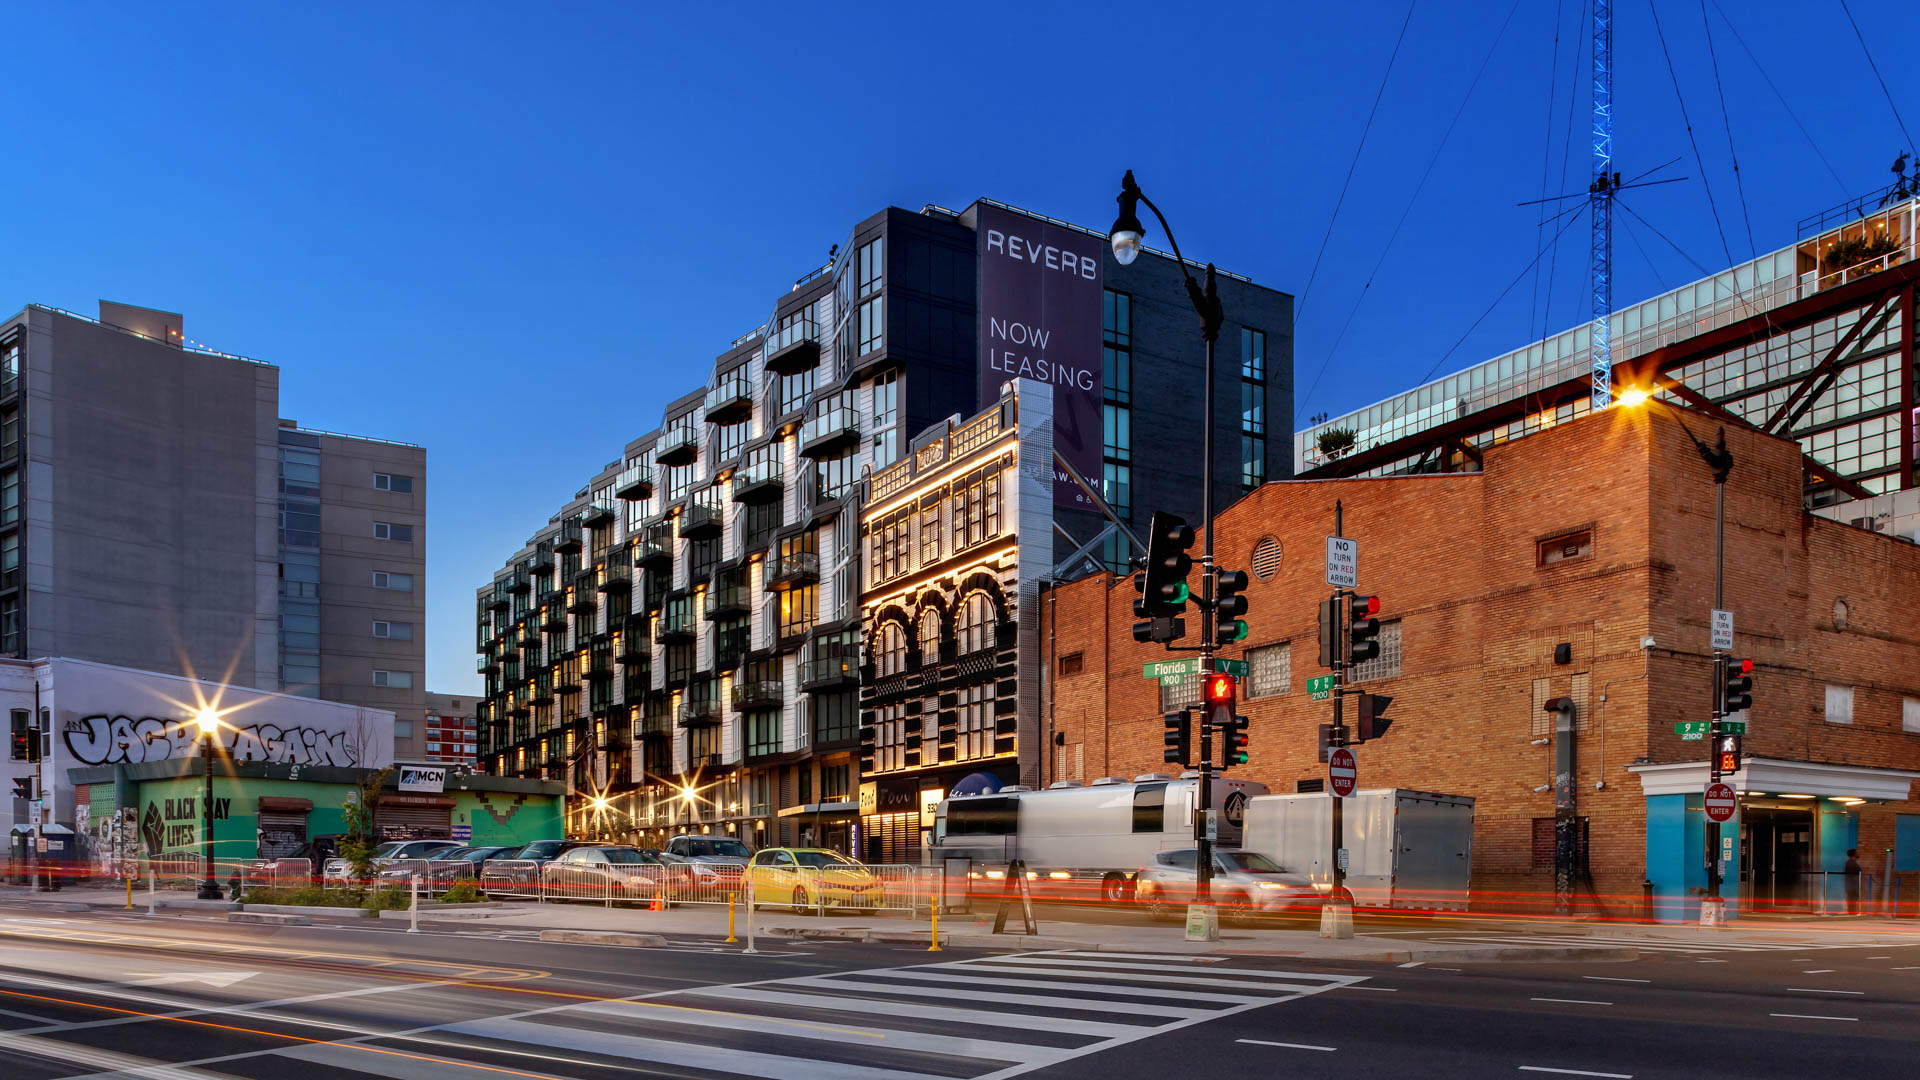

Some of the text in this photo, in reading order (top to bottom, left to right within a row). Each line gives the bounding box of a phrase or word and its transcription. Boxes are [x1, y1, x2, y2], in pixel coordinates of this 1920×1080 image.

[987, 229, 1097, 280] REVERB
[991, 316, 1050, 350] NOW
[991, 348, 1094, 391] LEASING
[1335, 541, 1349, 551] NO
[1333, 553, 1351, 562] TURN
[1329, 563, 1354, 574] ON RED
[1330, 574, 1354, 584] ARROW
[1718, 613, 1727, 621] NO
[1154, 661, 1186, 676] Florida
[1222, 660, 1231, 673] V
[1164, 674, 1180, 685] 900
[1314, 679, 1319, 690] 9
[1312, 690, 1328, 700] 2100
[1685, 723, 1691, 733] 9
[1333, 757, 1353, 767] DO NOT
[418, 770, 444, 782] MCN
[1709, 790, 1731, 798] DO NOT
[165, 797, 196, 821] BLACK
[1711, 807, 1730, 815] ENTER
[167, 824, 195, 848] LIVES
